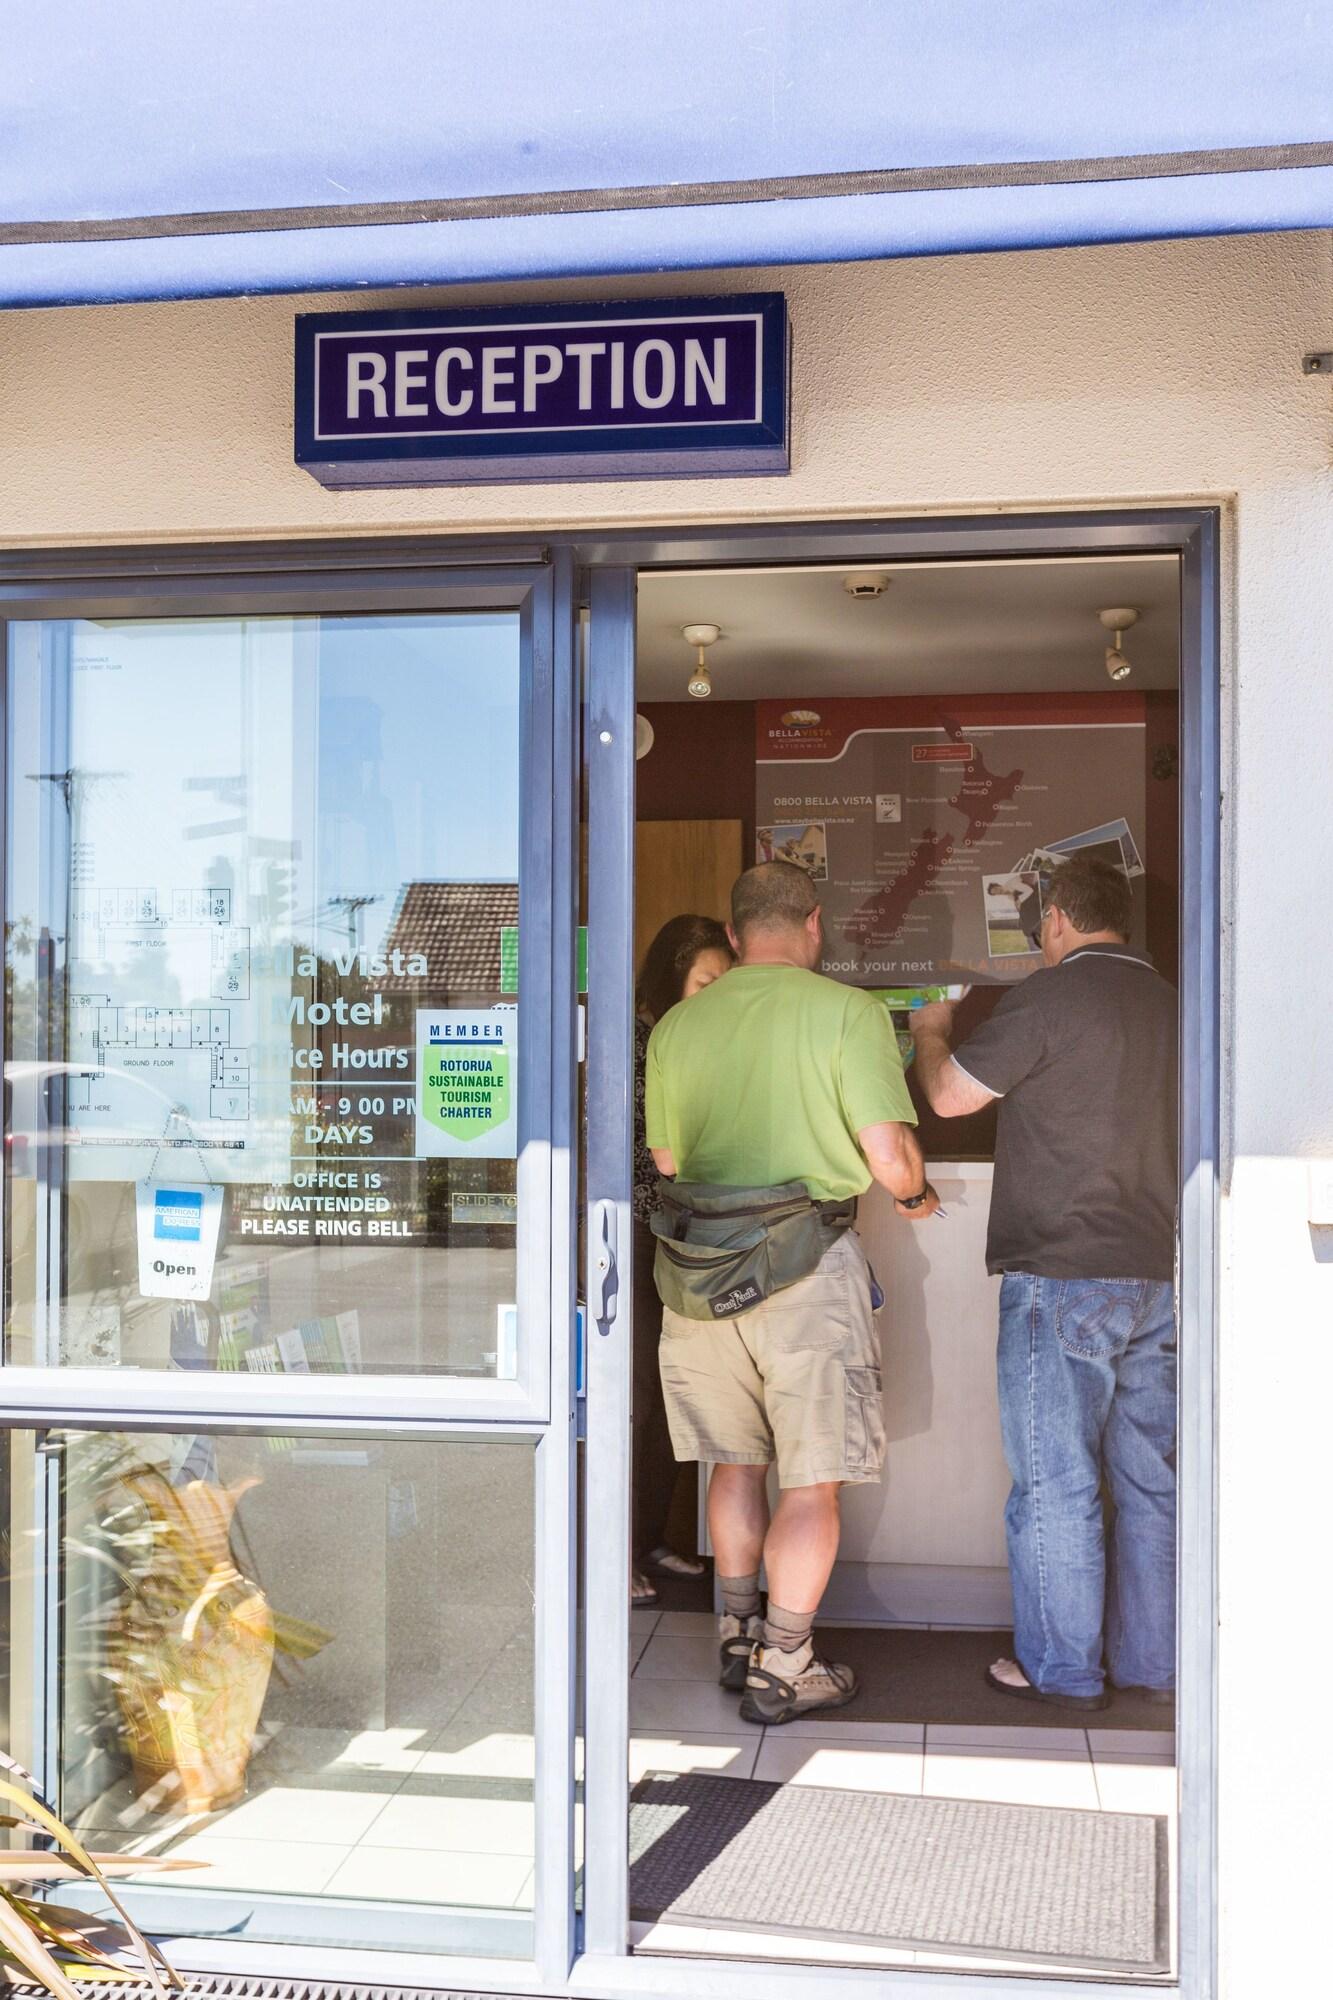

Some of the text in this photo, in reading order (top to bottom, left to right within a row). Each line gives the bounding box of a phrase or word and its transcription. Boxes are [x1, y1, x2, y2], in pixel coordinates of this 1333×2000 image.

[347, 337, 727, 419] RECEPTION
[774, 796, 873, 806] 0800 BELLA VISTA
[334, 945, 429, 977] Vista
[822, 959, 859, 972] book
[864, 961, 897, 974] your
[902, 960, 934, 972] next
[272, 994, 383, 1025] Motel
[430, 1025, 503, 1036] MEMBER
[123, 1059, 174, 1067] GROUND FLOOR
[332, 1043, 409, 1069] Hours
[440, 1060, 493, 1072] ROTORUA
[429, 1076, 504, 1088] SUSTAINABLE
[440, 1091, 492, 1103] TOURISM
[440, 1107, 492, 1119] CHARTER
[304, 1125, 374, 1144] DAYS
[293, 1173, 358, 1189] OFFICE
[364, 1173, 382, 1188] IS
[263, 1197, 391, 1212] UNATTENDED
[456, 1195, 494, 1207] SLIDE
[155, 1207, 198, 1217] AMERICAN
[241, 1220, 413, 1237] PLEASE RING BELL
[153, 1260, 197, 1276] Open
